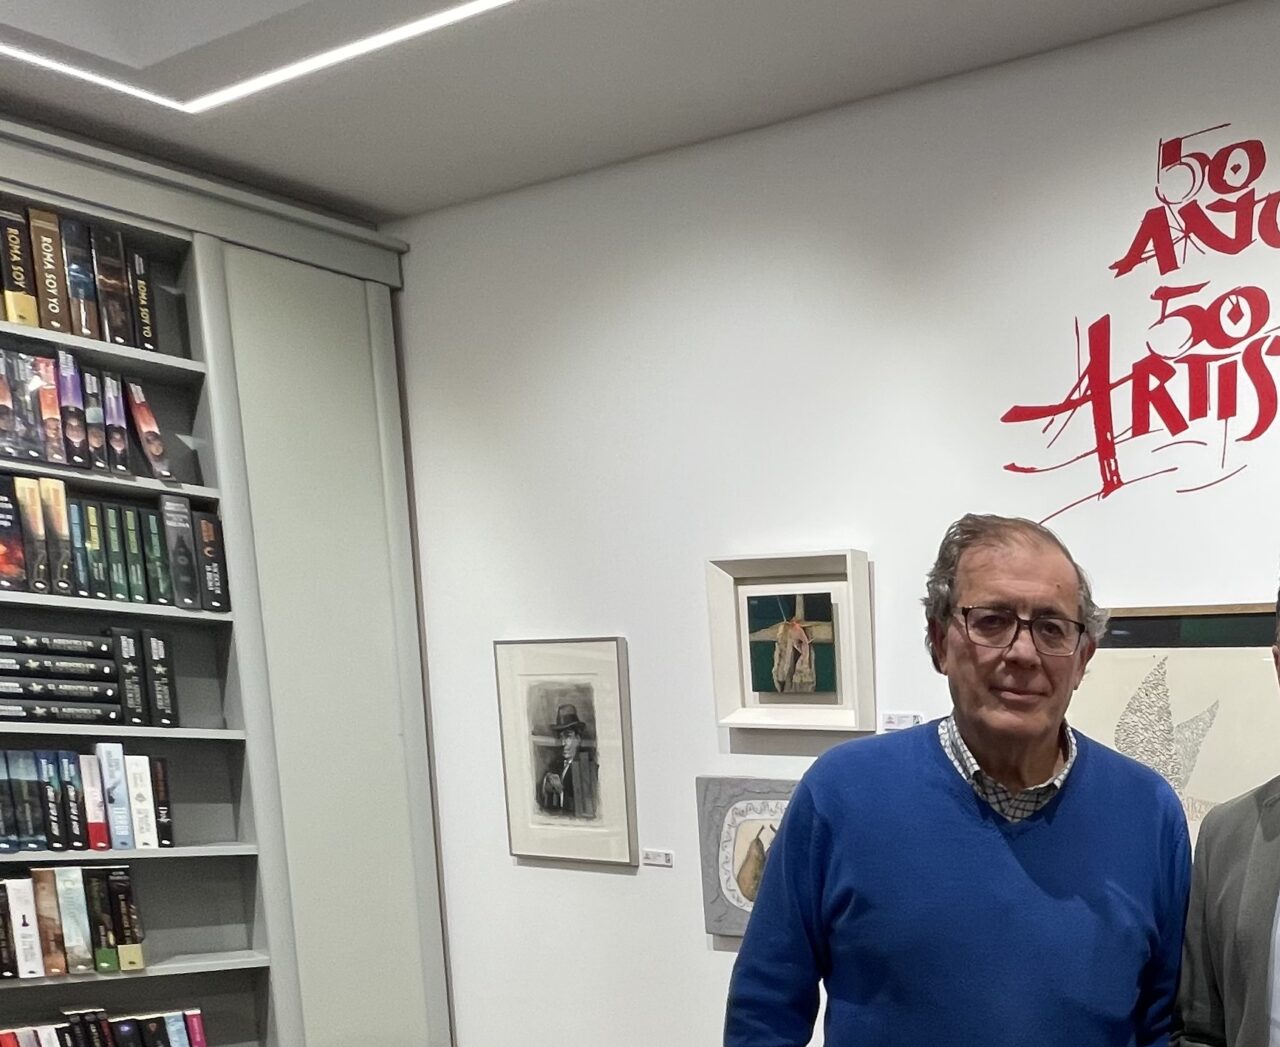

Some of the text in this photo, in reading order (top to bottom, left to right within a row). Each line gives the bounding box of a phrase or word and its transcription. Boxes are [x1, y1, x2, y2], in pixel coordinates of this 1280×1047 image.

[1155, 124, 1266, 204] 50
[7, 227, 26, 288] ROMA SOY
[41, 236, 60, 313] ROMA SOY YO
[137, 280, 148, 304] ROMA
[139, 307, 151, 325] SOY
[1147, 281, 1270, 359] 50
[143, 326, 152, 338] YO
